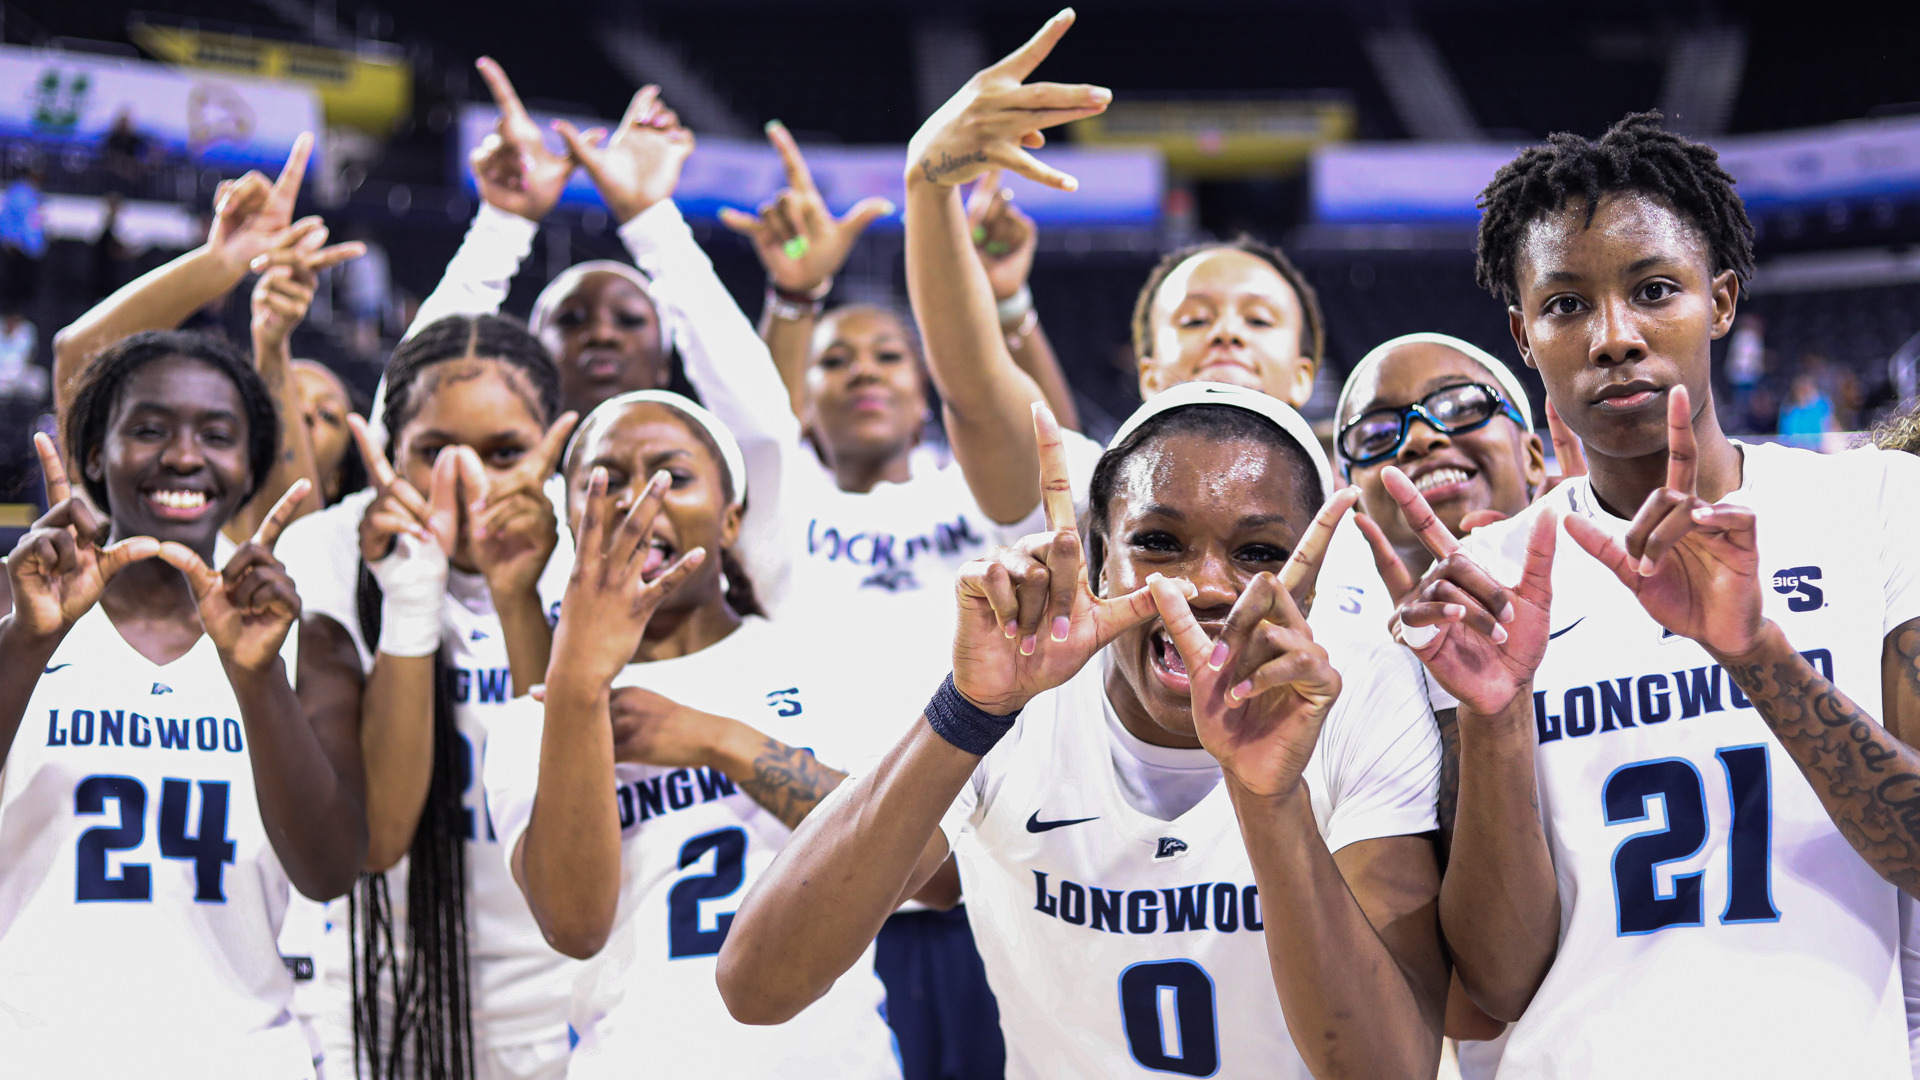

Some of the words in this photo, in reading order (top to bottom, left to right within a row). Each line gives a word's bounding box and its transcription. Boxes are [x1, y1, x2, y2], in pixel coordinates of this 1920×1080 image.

[46, 709, 244, 753] LONGWOO
[1813, 691, 1898, 773] God
[74, 774, 238, 905] 24
[667, 825, 750, 961] 2
[1600, 741, 1784, 938] 21
[1117, 958, 1221, 1079] 0
